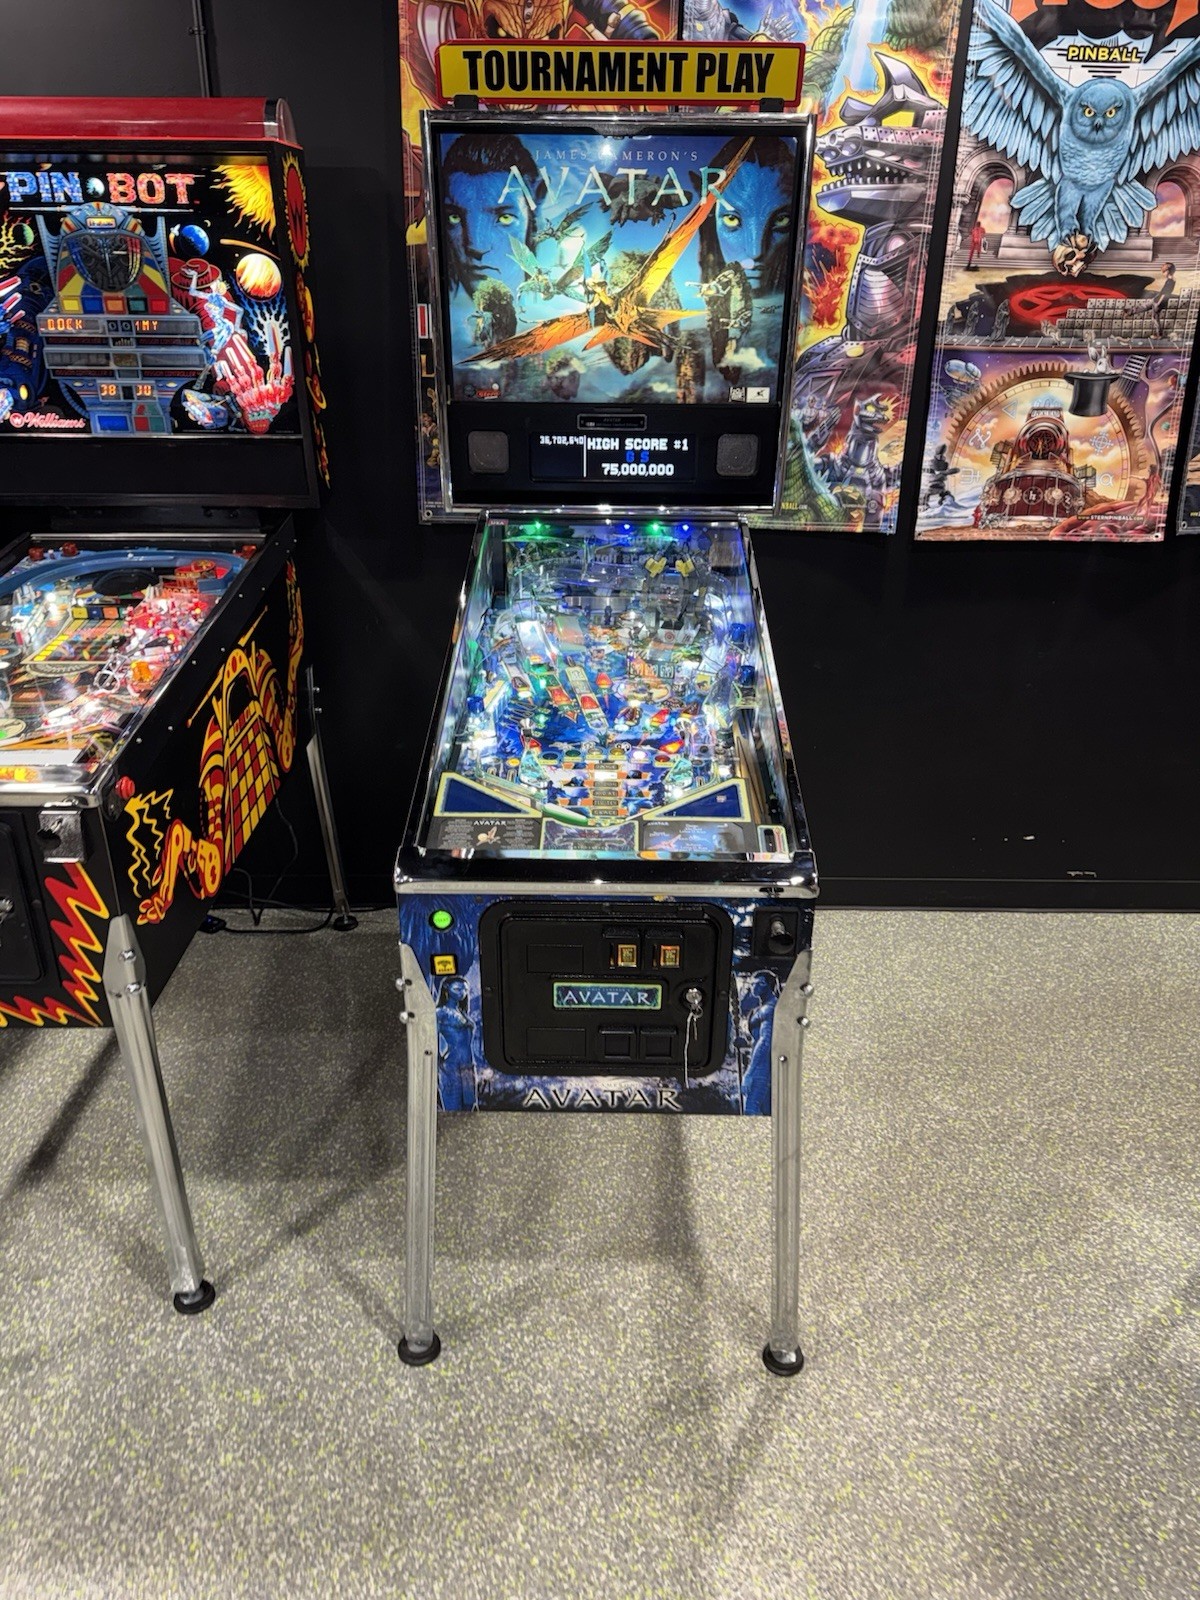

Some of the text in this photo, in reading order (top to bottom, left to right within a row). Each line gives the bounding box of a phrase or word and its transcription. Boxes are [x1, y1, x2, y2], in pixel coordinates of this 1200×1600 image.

[1067, 46, 1142, 62] PINBALL
[462, 50, 775, 93] TOURNAMENT PLAY
[535, 150, 587, 160] JAMES
[5, 171, 195, 204] PIN BOT
[497, 165, 735, 211] AVATAR
[24, 412, 86, 428] Williams
[587, 437, 689, 451] HIGH SCORE #1
[601, 463, 675, 477] 75,000,000
[563, 990, 651, 1005] AVATAR
[523, 1087, 683, 1111] AVATAR
